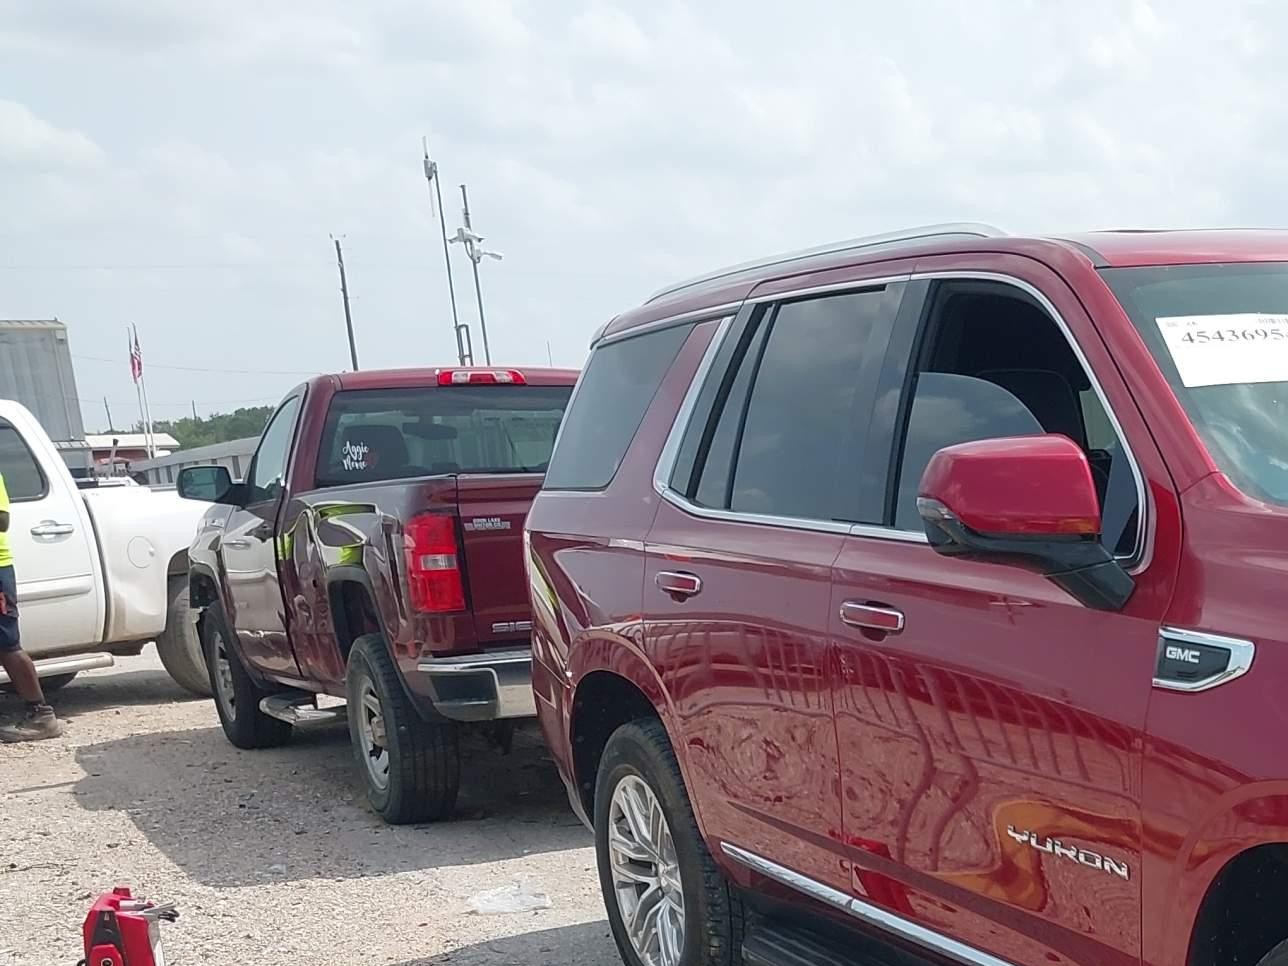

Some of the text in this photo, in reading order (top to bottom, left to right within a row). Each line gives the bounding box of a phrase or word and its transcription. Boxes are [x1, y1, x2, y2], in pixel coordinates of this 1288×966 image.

[342, 440, 369, 461] Aggie
[492, 620, 533, 633] SIE
[1165, 645, 1200, 663] GMC
[1006, 824, 1130, 881] YUKON
